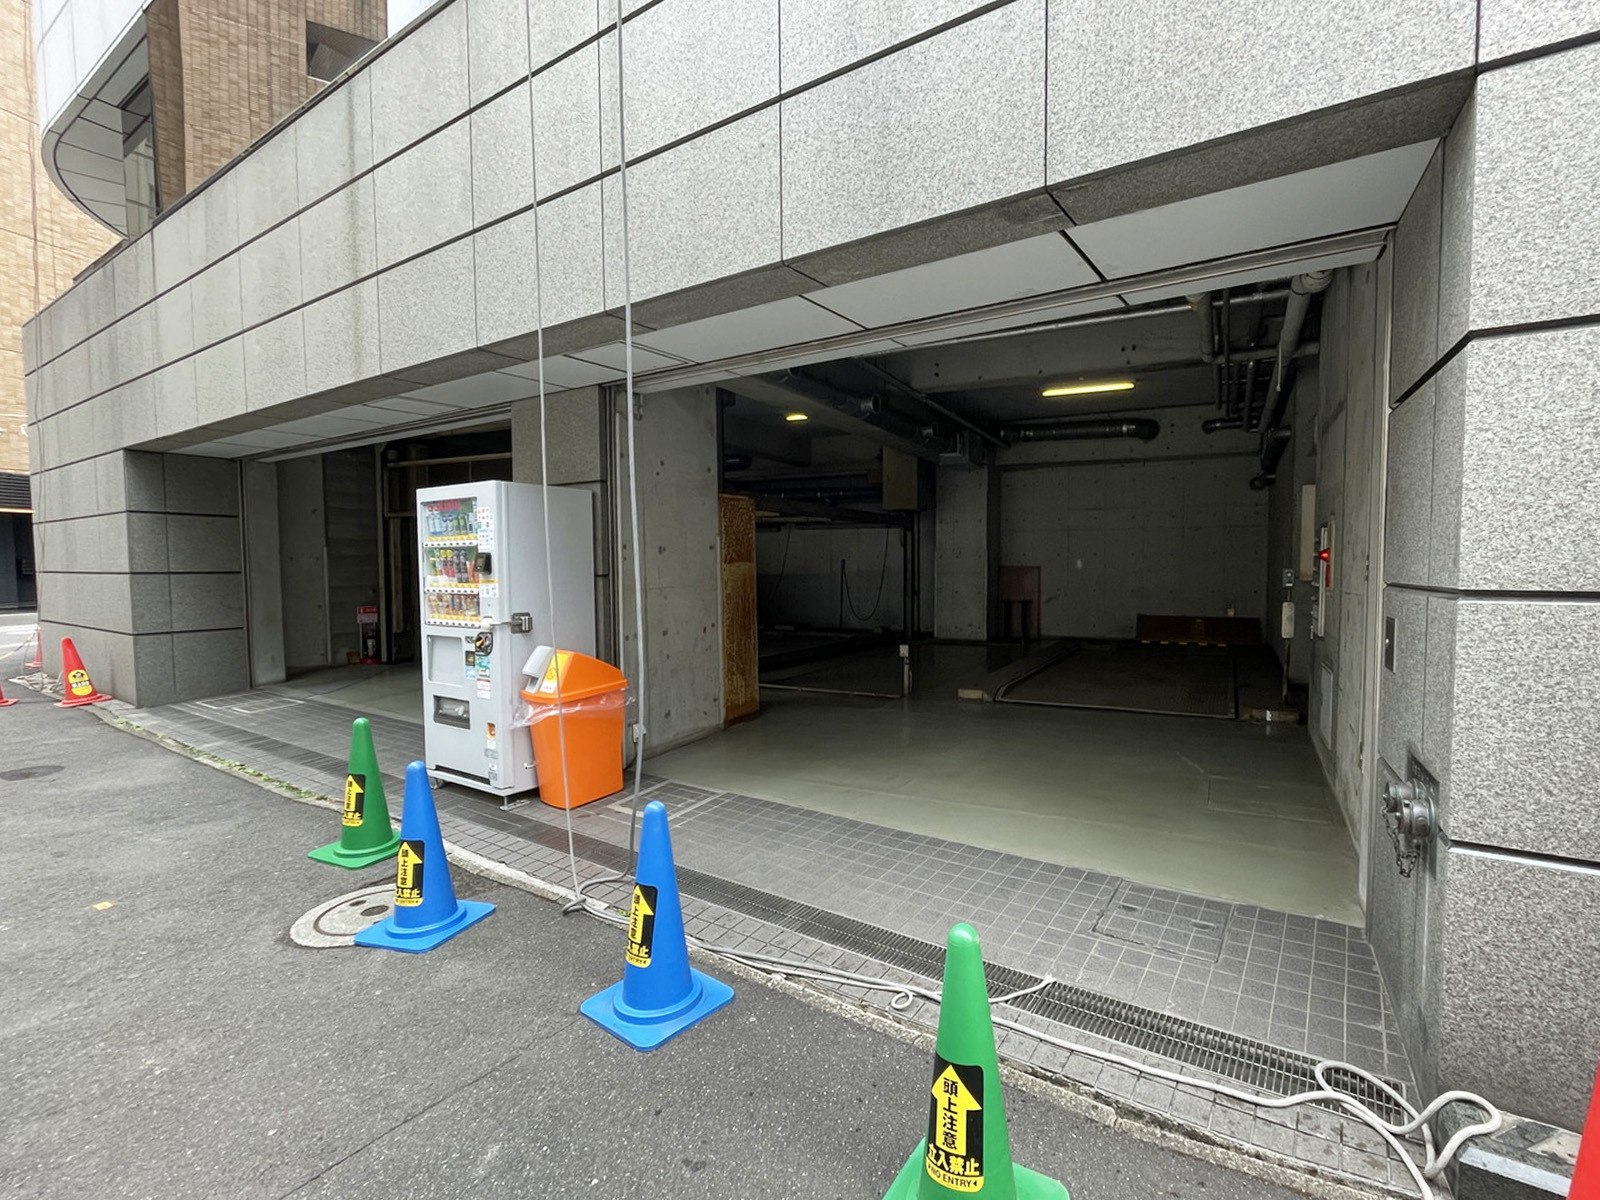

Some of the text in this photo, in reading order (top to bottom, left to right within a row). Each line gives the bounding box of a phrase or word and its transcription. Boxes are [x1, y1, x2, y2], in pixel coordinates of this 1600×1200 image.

[942, 1077, 959, 1151] 頭上注意
[927, 1143, 980, 1176] 立入禁止
[942, 1175, 972, 1187] ENTRY
